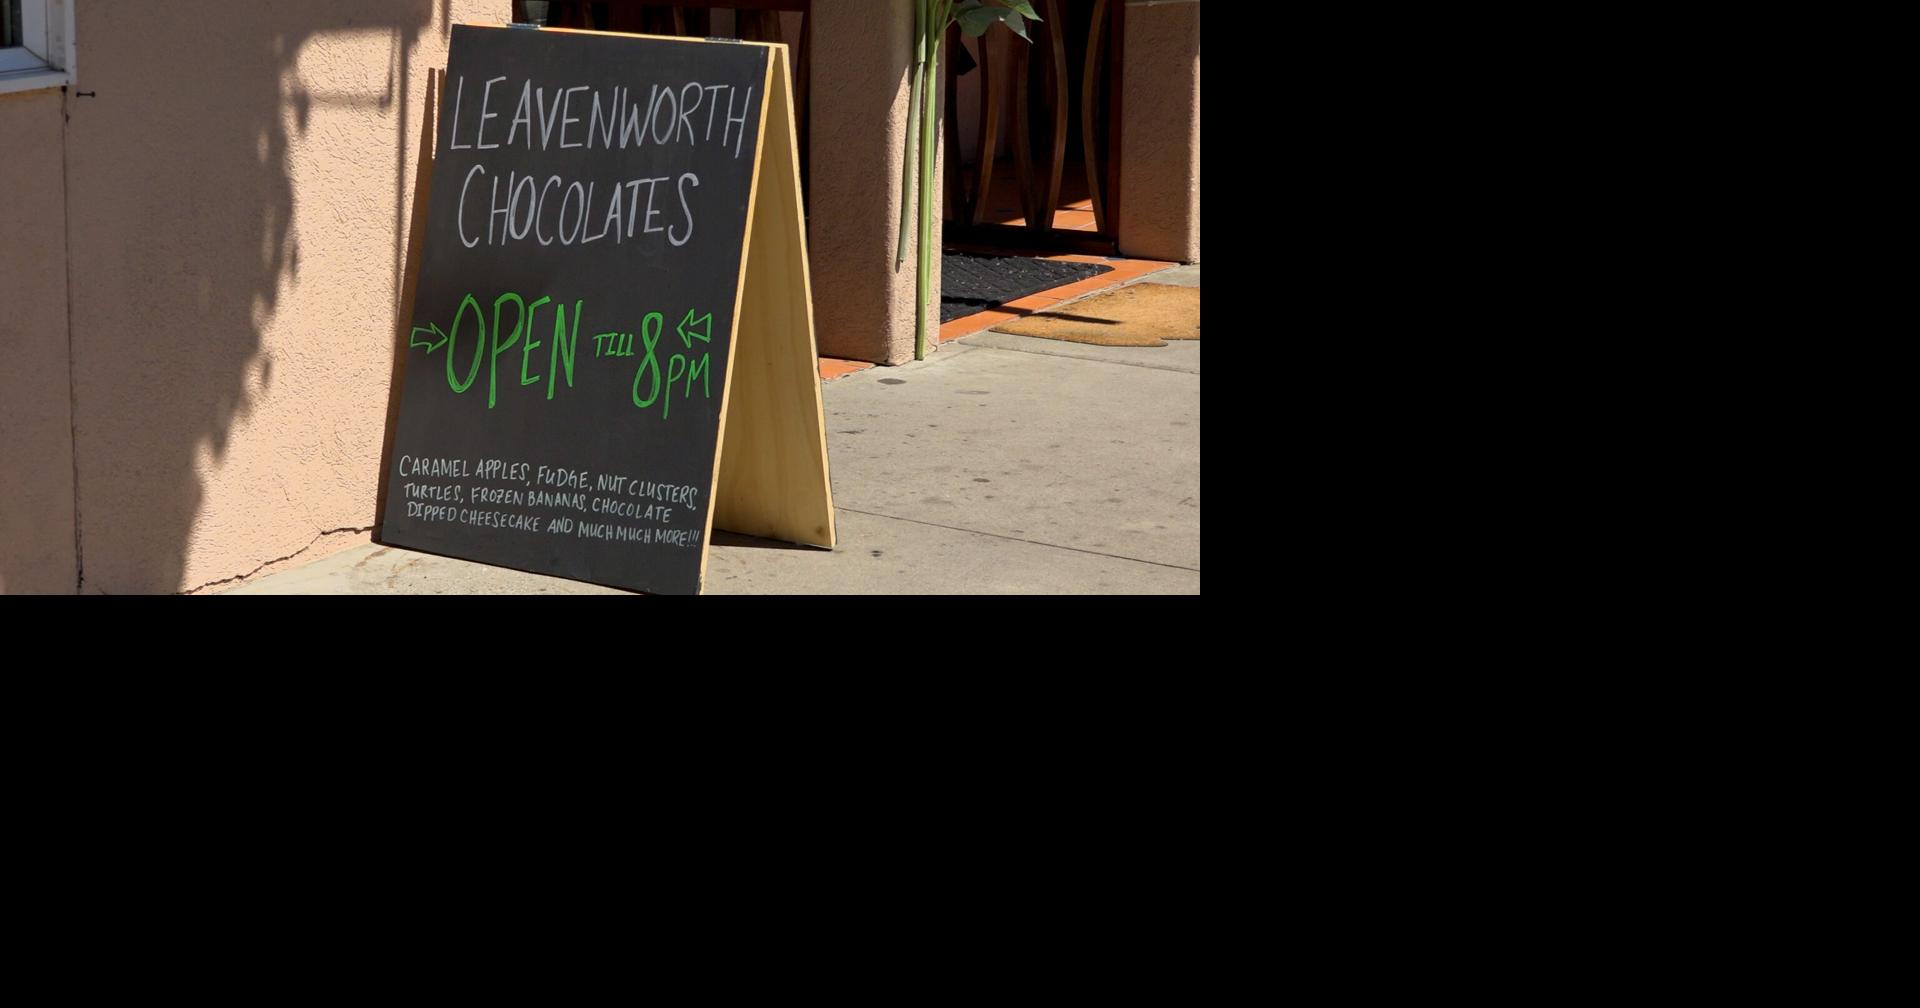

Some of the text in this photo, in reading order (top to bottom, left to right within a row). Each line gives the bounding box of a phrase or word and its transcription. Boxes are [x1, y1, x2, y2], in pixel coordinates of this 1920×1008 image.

[450, 76, 752, 158] LEAVENWORTH
[458, 164, 699, 247] CHOCOLATES
[446, 292, 711, 419] OPEN TILL 8 PM
[399, 455, 698, 511] CARAMEL APPLES, FUDGE, NUT CLUSTERS,
[403, 482, 672, 523] TURTLES, FROZEN BANANAS, CHOCOLATE
[407, 501, 700, 548] DIPPED CHEESECAKE AND MUCH MUCH MORE!!!
